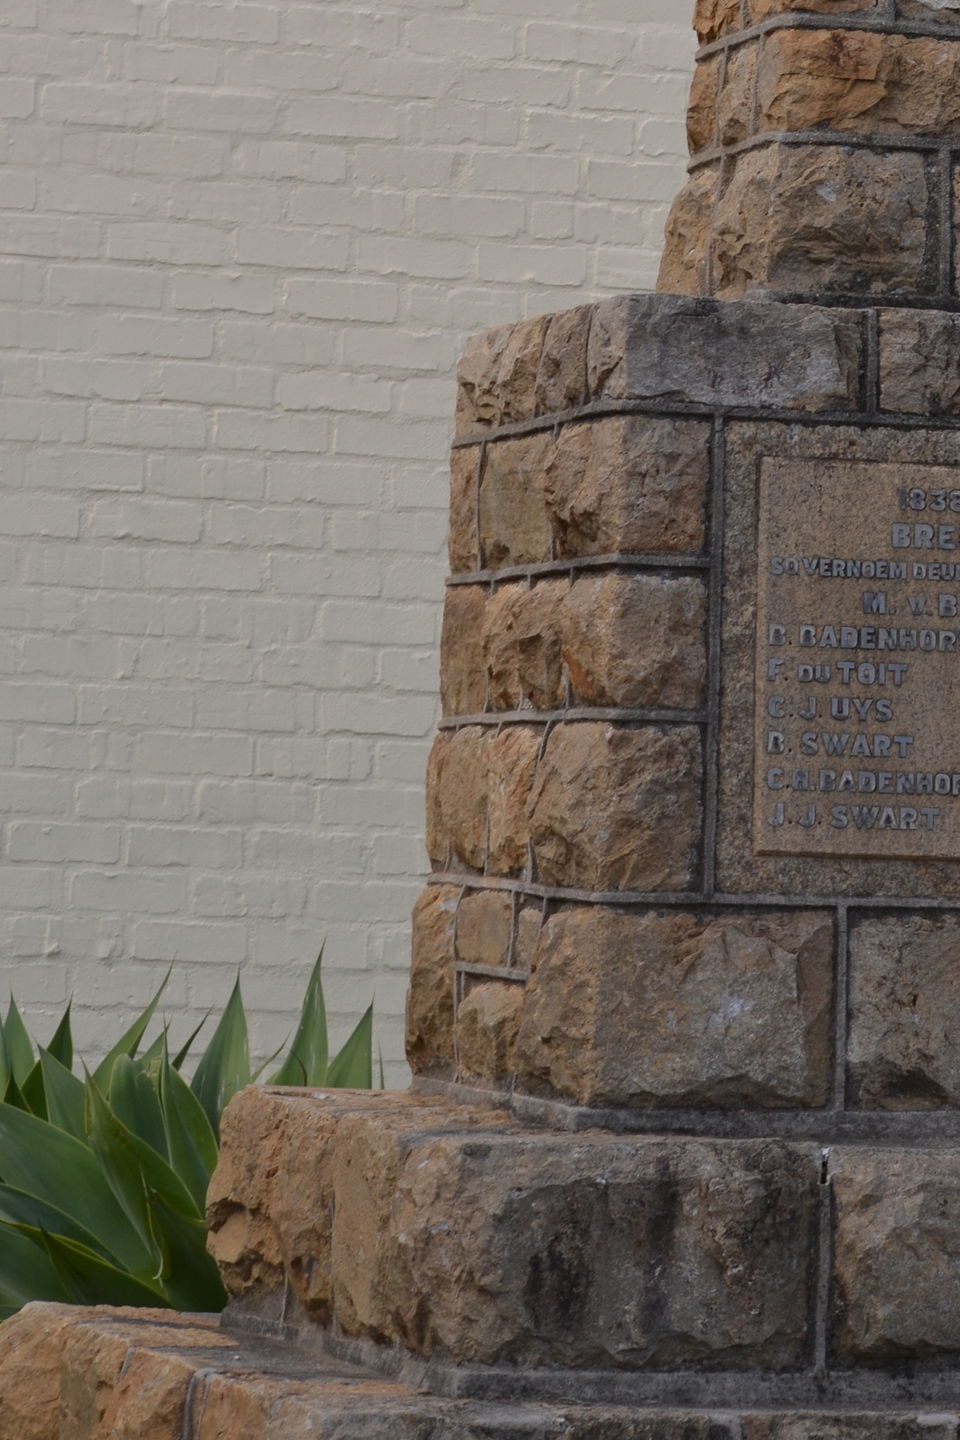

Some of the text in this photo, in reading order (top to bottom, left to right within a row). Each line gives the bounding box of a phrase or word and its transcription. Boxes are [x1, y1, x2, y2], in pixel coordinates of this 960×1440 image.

[771, 557, 799, 576] SO
[803, 558, 907, 580] VERNOEM
[830, 698, 893, 722] UYS
[801, 732, 914, 758] SWART
[830, 804, 940, 830] SWART
